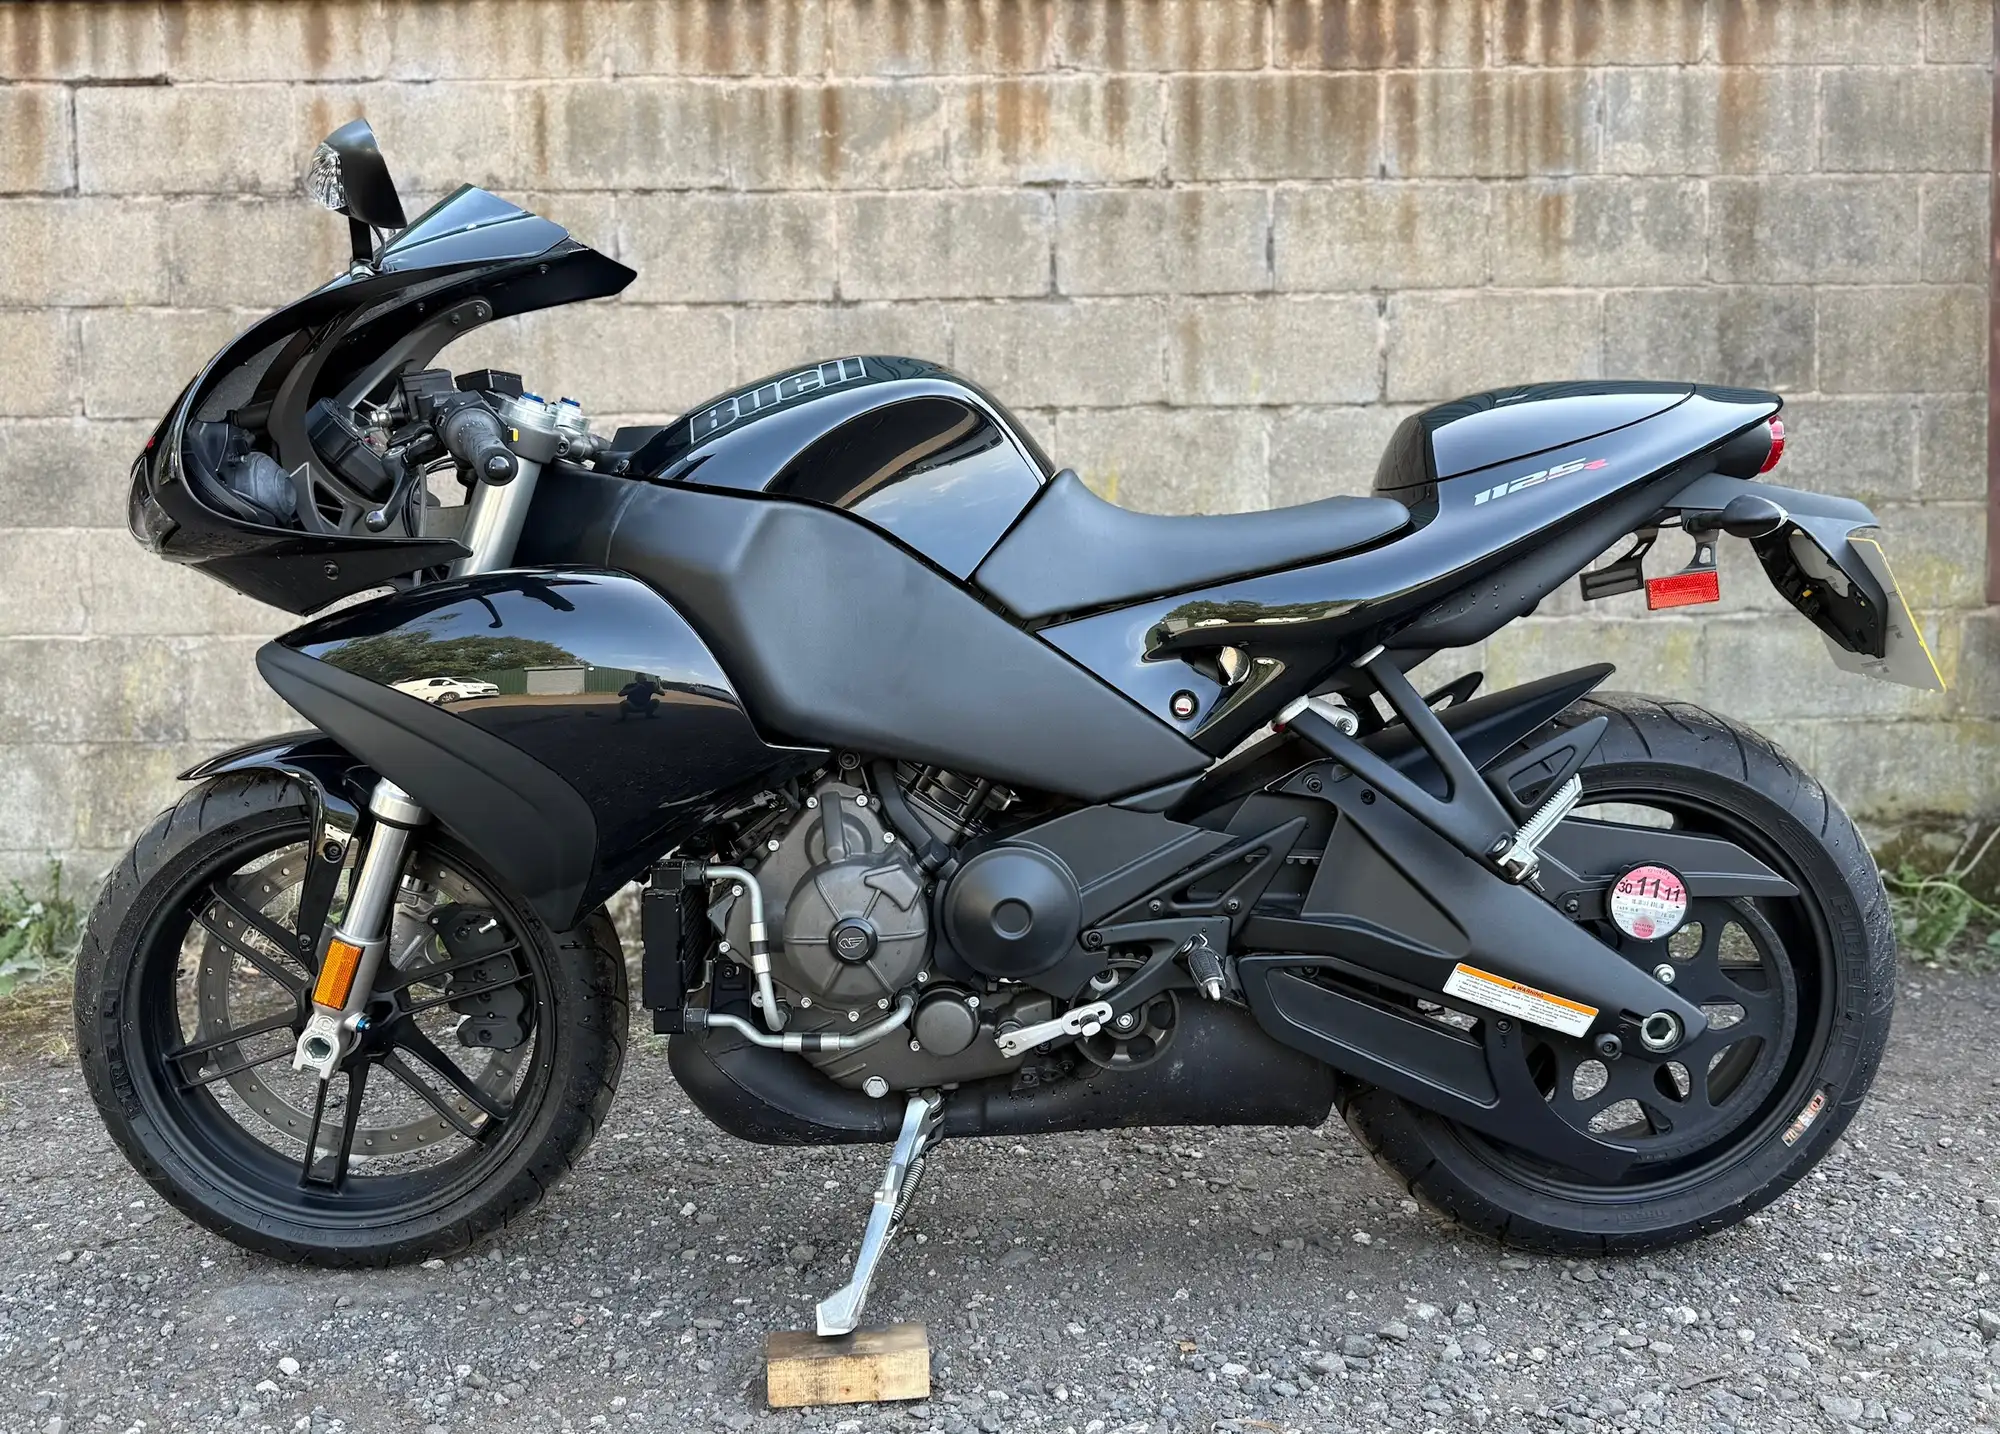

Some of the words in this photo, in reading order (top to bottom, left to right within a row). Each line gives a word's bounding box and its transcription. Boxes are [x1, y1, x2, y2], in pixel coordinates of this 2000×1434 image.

[690, 356, 867, 444] Buell
[1618, 881, 1632, 894] 30
[1637, 876, 1660, 899] 11
[1664, 887, 1681, 902] 11
[1517, 984, 1544, 999] WARNING
[1830, 896, 1867, 1047] PIRELLI
[102, 989, 143, 1120] PIRELLI
